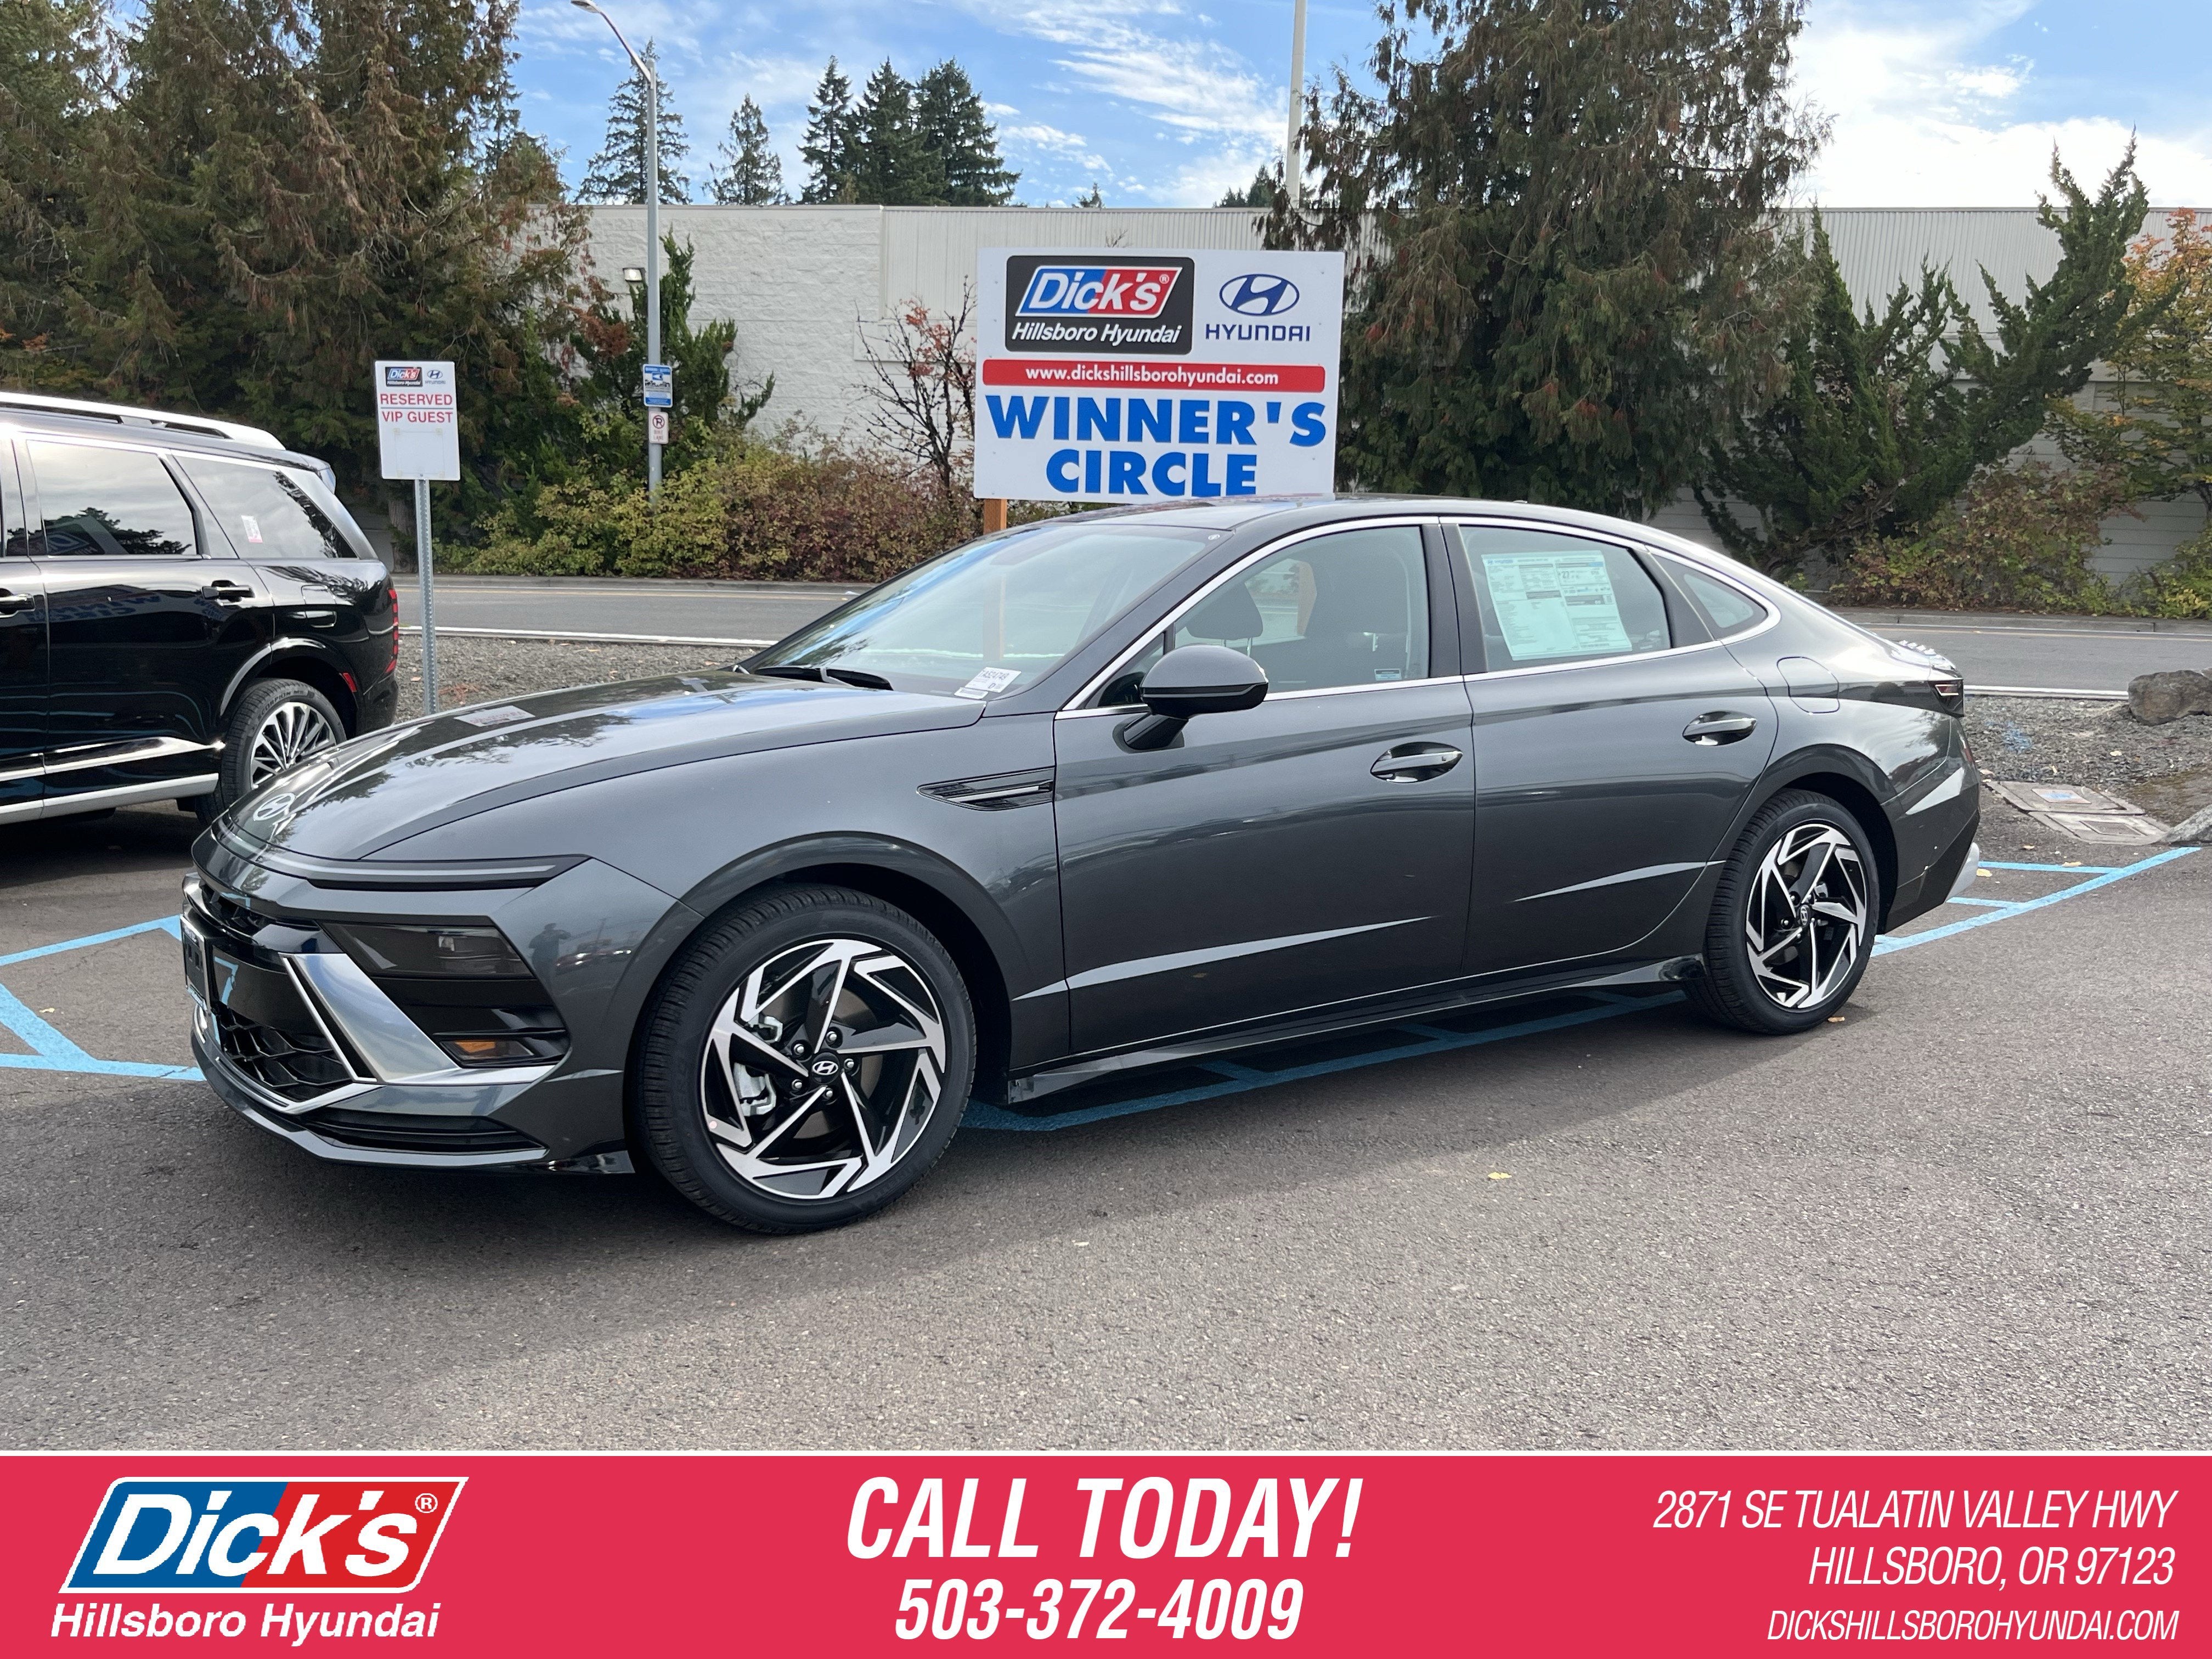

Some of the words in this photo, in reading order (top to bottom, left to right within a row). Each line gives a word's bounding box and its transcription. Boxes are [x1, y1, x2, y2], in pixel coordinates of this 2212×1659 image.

[1011, 322, 1098, 342] Hillsboro
[1101, 323, 1182, 347] Hyundai
[1205, 324, 1310, 342] HYUNDAI
[1026, 364, 1279, 387] www.dickshillsborohyundai.com
[380, 393, 453, 405] RESERVED
[382, 411, 403, 423] VIP
[408, 411, 453, 424] GUEST
[985, 395, 1327, 447] WINNER'S
[1046, 448, 1257, 498] CIRCLE
